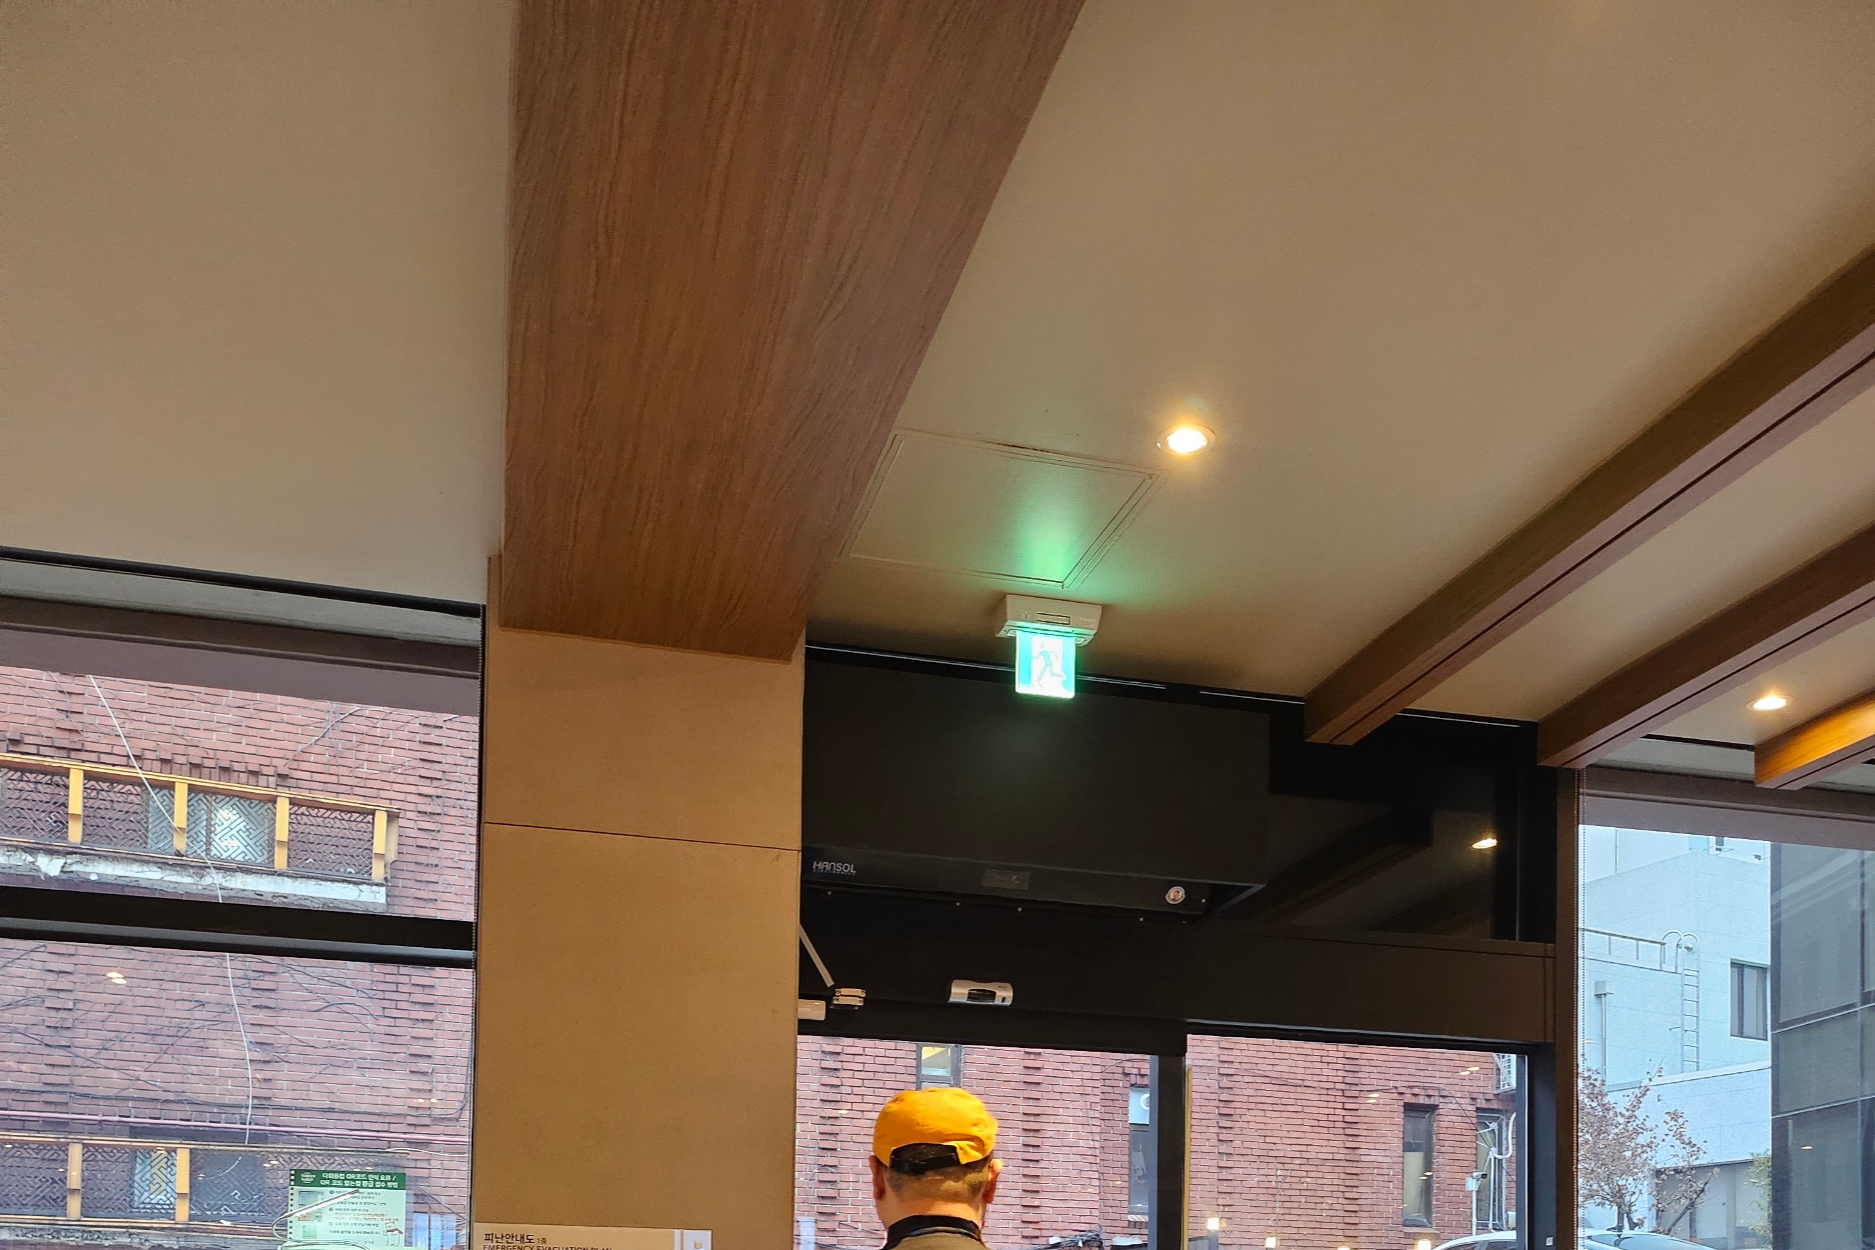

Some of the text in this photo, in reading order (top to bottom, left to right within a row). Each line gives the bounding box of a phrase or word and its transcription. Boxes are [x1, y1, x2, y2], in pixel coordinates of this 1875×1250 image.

[812, 861, 857, 873] HANSOL
[322, 1172, 345, 1180] 다회용컵
[483, 1232, 535, 1244] 피난안내도
